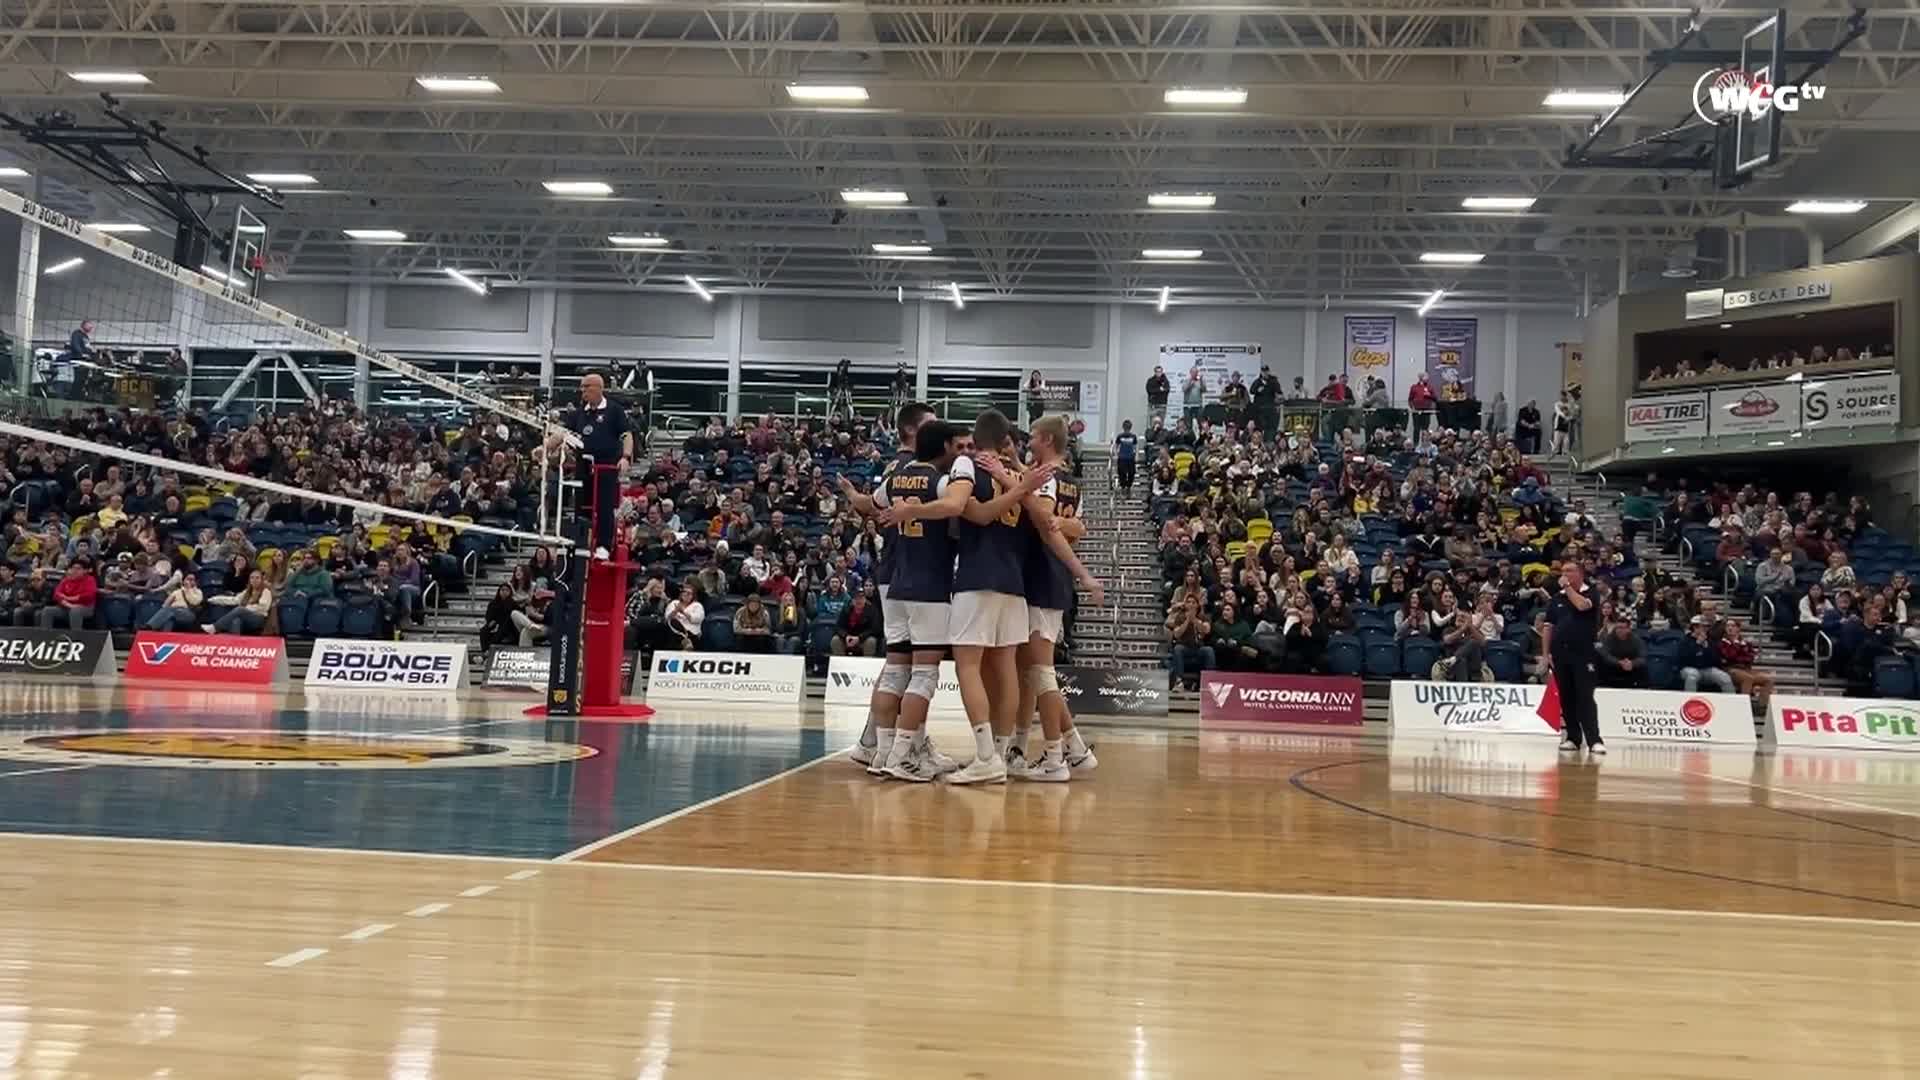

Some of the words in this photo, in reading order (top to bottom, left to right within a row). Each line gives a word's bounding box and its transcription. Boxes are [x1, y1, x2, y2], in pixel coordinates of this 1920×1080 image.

[38, 206, 82, 235] BOBCATS
[1729, 288, 1787, 304] BOBCAT
[1797, 283, 1826, 297] DEN
[1837, 394, 1897, 409] SOURCE
[181, 644, 215, 656] GREAT
[217, 645, 277, 659] CANADIAN
[191, 656, 208, 667] OIL
[210, 658, 261, 670] CHANGE
[320, 652, 453, 671] BOUNCE
[682, 660, 752, 675] KOCH
[317, 669, 388, 682] RADIO
[407, 672, 449, 684] 96.1
[1415, 684, 1535, 708] UNIVERSAL
[1434, 701, 1502, 725] Truck
[1622, 716, 1678, 727] LIQUOR
[1782, 708, 1858, 733] Pita
[1865, 712, 1918, 735] Pit
[1640, 727, 1712, 738] LOTTERIES
